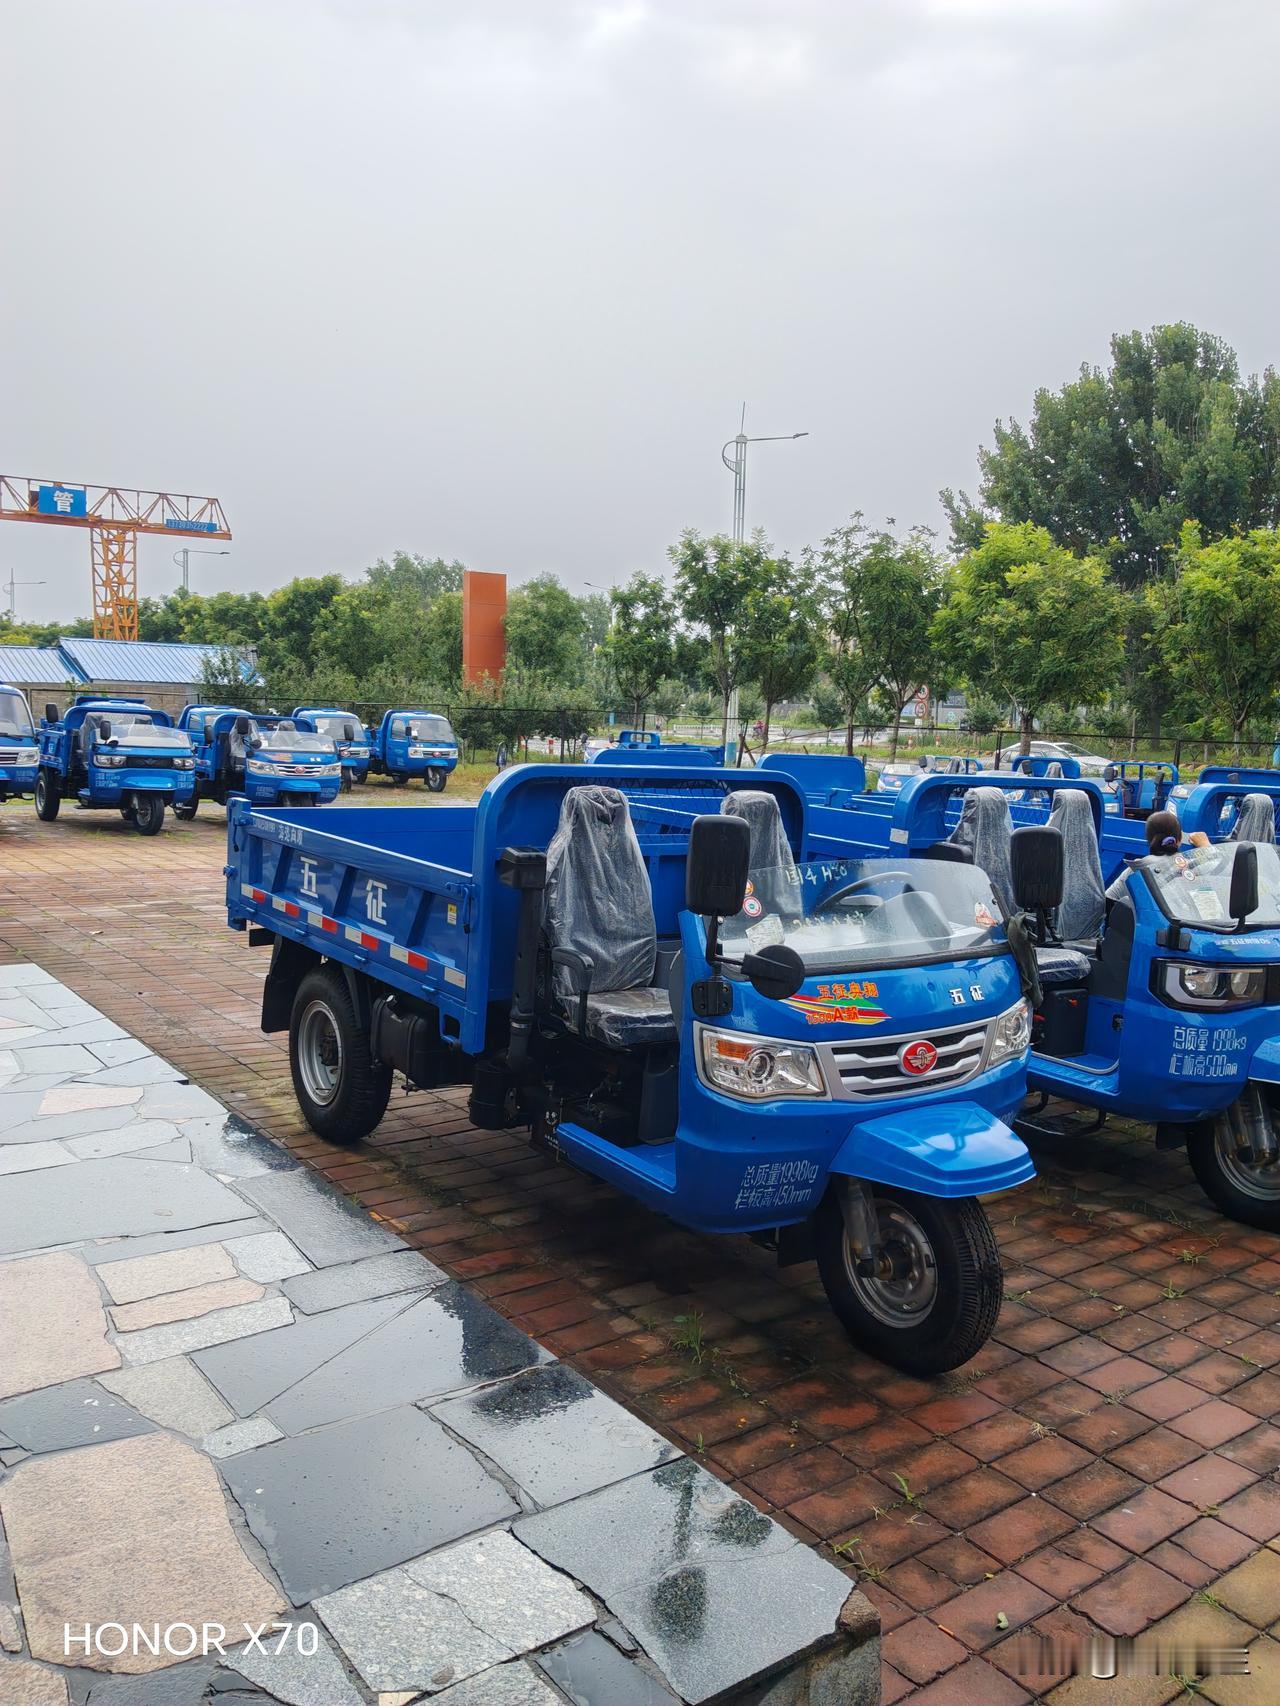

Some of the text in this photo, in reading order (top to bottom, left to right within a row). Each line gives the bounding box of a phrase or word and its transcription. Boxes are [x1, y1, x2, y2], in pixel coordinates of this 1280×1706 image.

[53, 490, 74, 513] 管
[300, 856, 388, 925] 五征
[949, 984, 985, 1005] 五征
